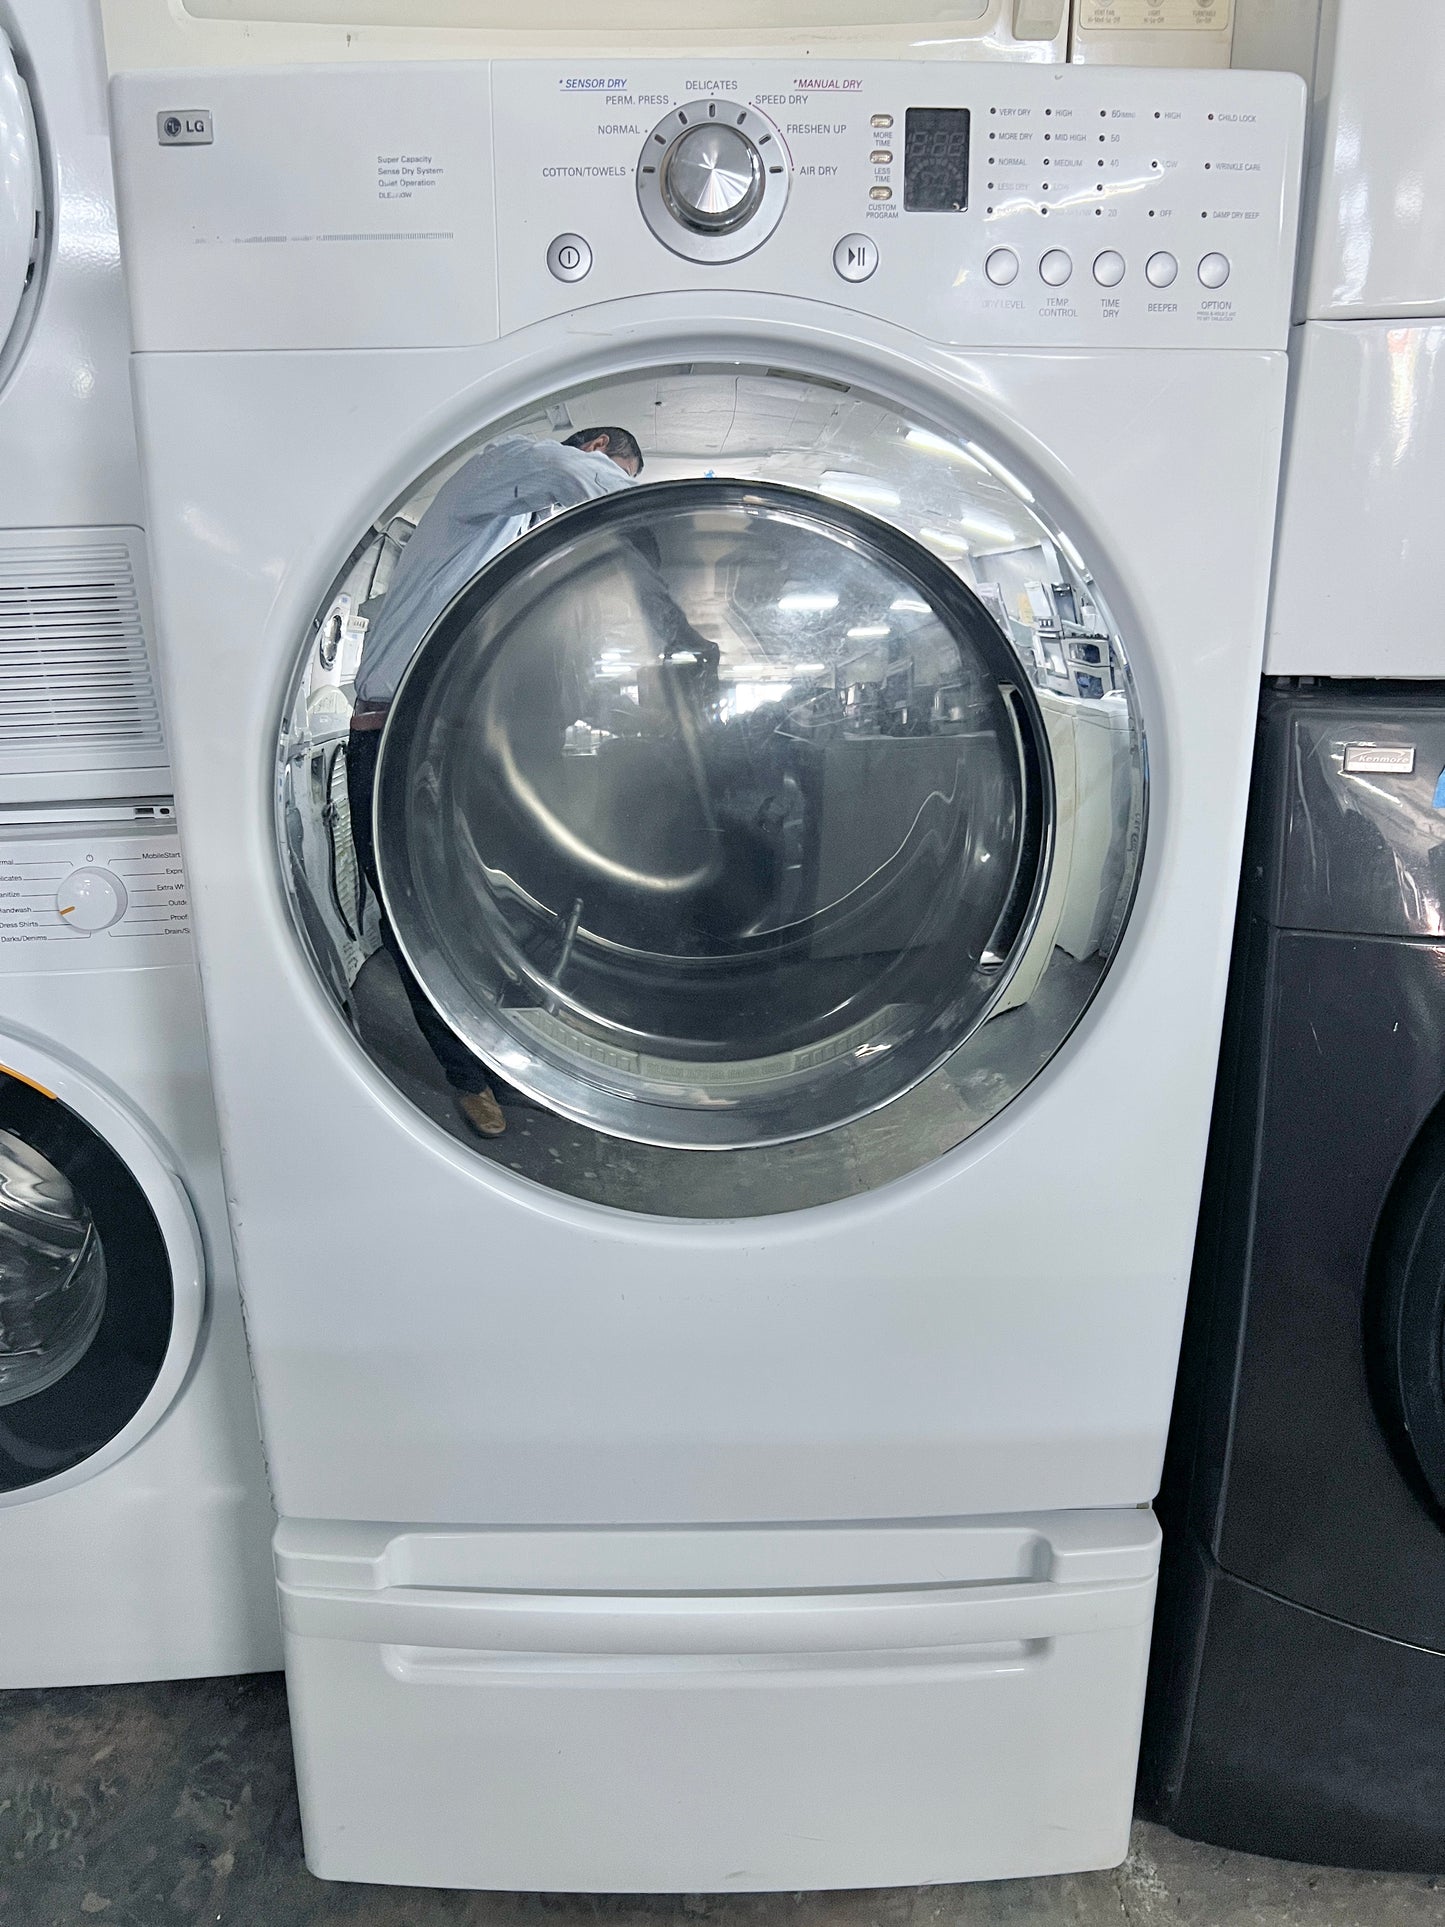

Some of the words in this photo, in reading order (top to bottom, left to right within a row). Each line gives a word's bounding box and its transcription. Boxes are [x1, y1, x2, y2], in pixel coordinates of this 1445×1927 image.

[566, 79, 604, 88] SENSOR
[608, 79, 627, 88] DRY
[685, 80, 738, 90] DELICATES
[842, 80, 862, 88] DRY
[606, 96, 636, 104] PERM.
[638, 96, 670, 104] PRESS
[755, 95, 786, 104] SPEED
[788, 95, 808, 104] DRY
[1055, 109, 1072, 117] HIGH
[1218, 114, 1237, 122] CHILD
[186, 120, 204, 132] LG
[598, 125, 640, 134] NORMAL
[786, 124, 829, 134] FRESHEN
[832, 124, 847, 134] UP
[998, 132, 1016, 140] MORE
[1069, 134, 1086, 142] HIGH
[377, 156, 399, 164] Super
[400, 155, 432, 164] Capacity
[998, 158, 1026, 166] NORMAL
[1054, 159, 1083, 167] MEDIUM
[1110, 159, 1120, 167] 40
[1216, 162, 1244, 170] WRINKLE
[377, 167, 400, 175] Sense
[401, 168, 414, 176] Dry
[416, 167, 444, 176] System
[542, 167, 626, 177] COTTON/TOWELS
[800, 166, 816, 176] AIR
[818, 166, 838, 176] DRY
[400, 178, 436, 188] Operation
[1108, 209, 1118, 217] 20
[1160, 210, 1172, 218] OFF
[1244, 212, 1260, 220] BEEP
[1000, 300, 1025, 310] LEVEL
[1046, 298, 1069, 306] TEMP
[1100, 298, 1120, 308] TIME
[1201, 301, 1232, 310] OPTION
[1148, 304, 1178, 312] BEEPER
[1038, 308, 1078, 318] CONTROL
[1103, 309, 1120, 318] DRY
[1359, 755, 1409, 763] Kenmore
[19, 920, 38, 928] Shirts
